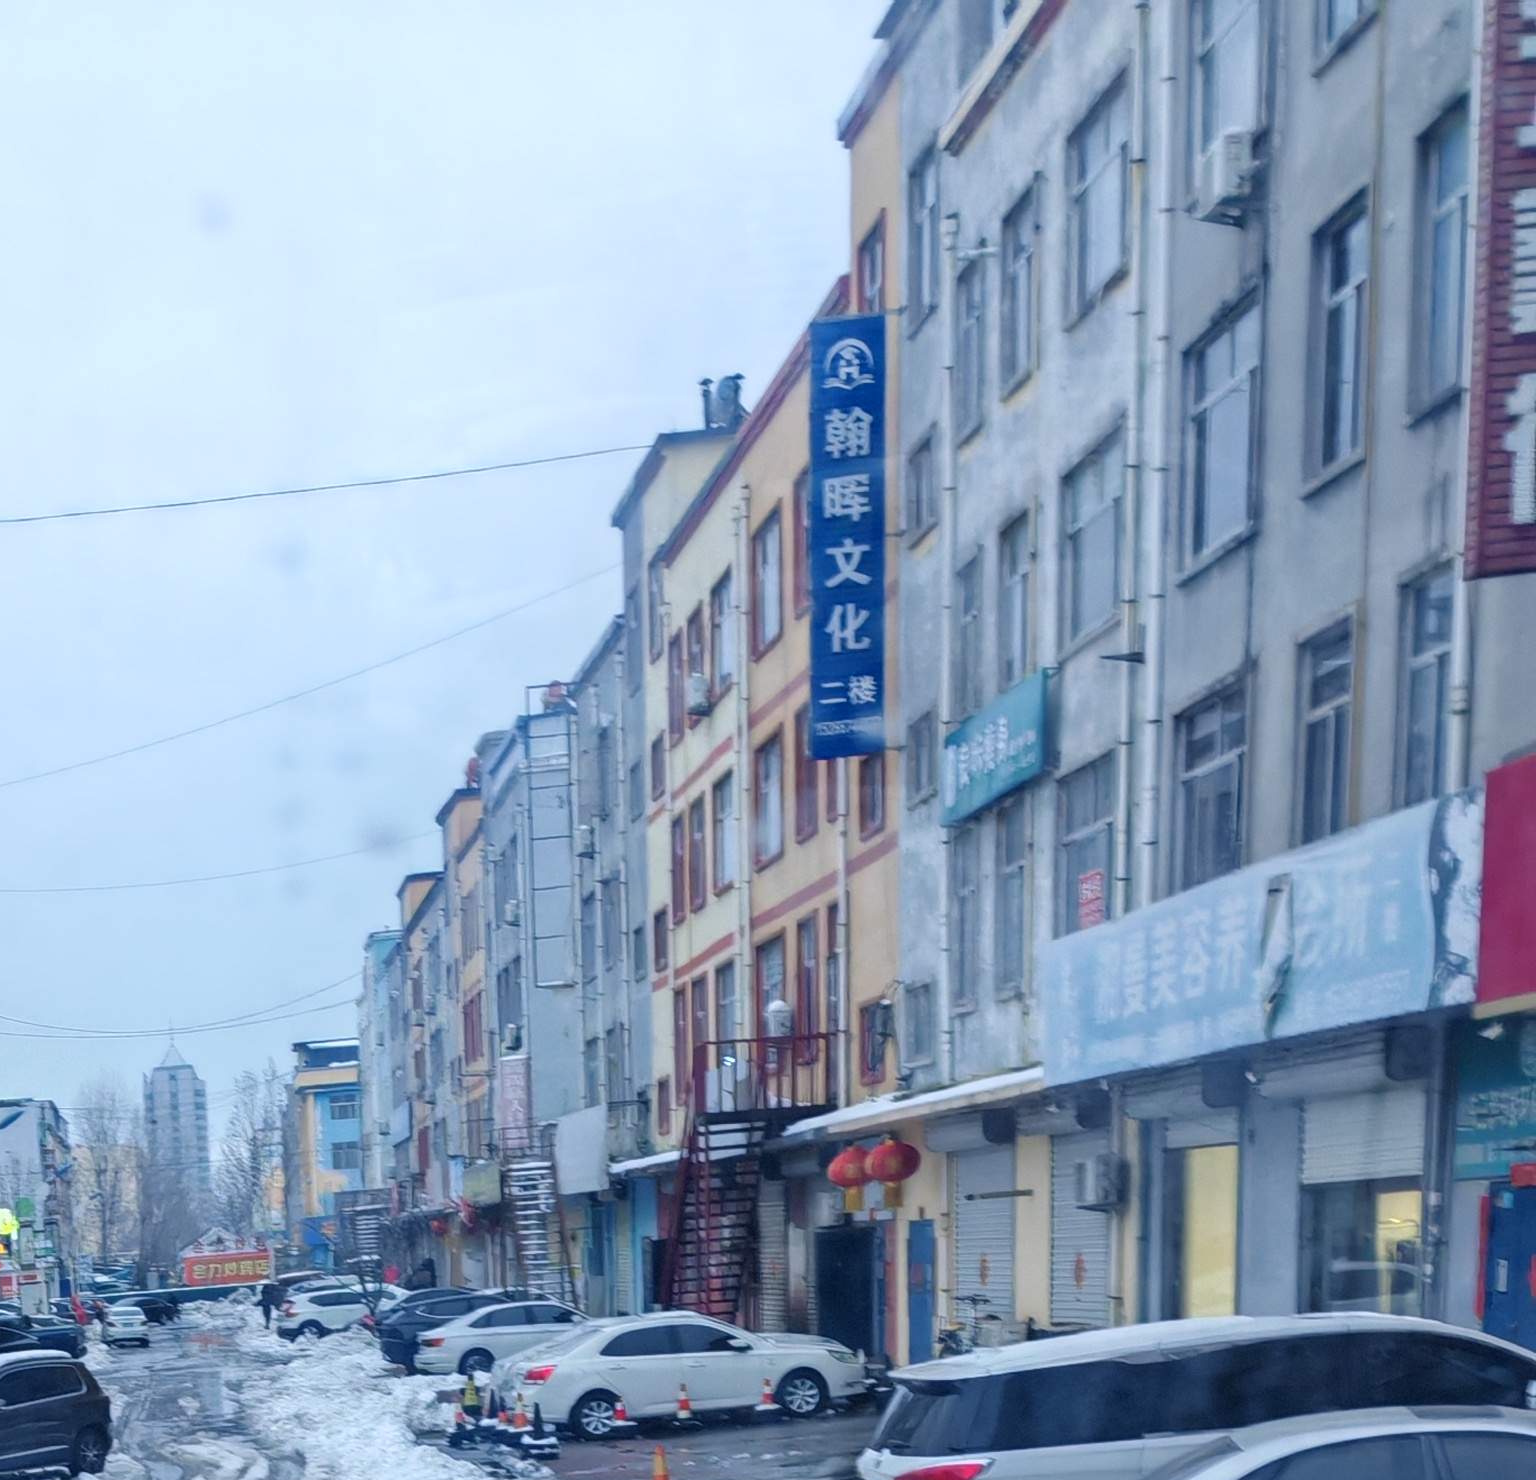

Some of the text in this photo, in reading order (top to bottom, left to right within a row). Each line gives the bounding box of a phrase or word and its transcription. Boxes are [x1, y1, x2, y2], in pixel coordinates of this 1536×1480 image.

[822, 406, 874, 653] 翰晖文化
[818, 675, 877, 706] 二楼
